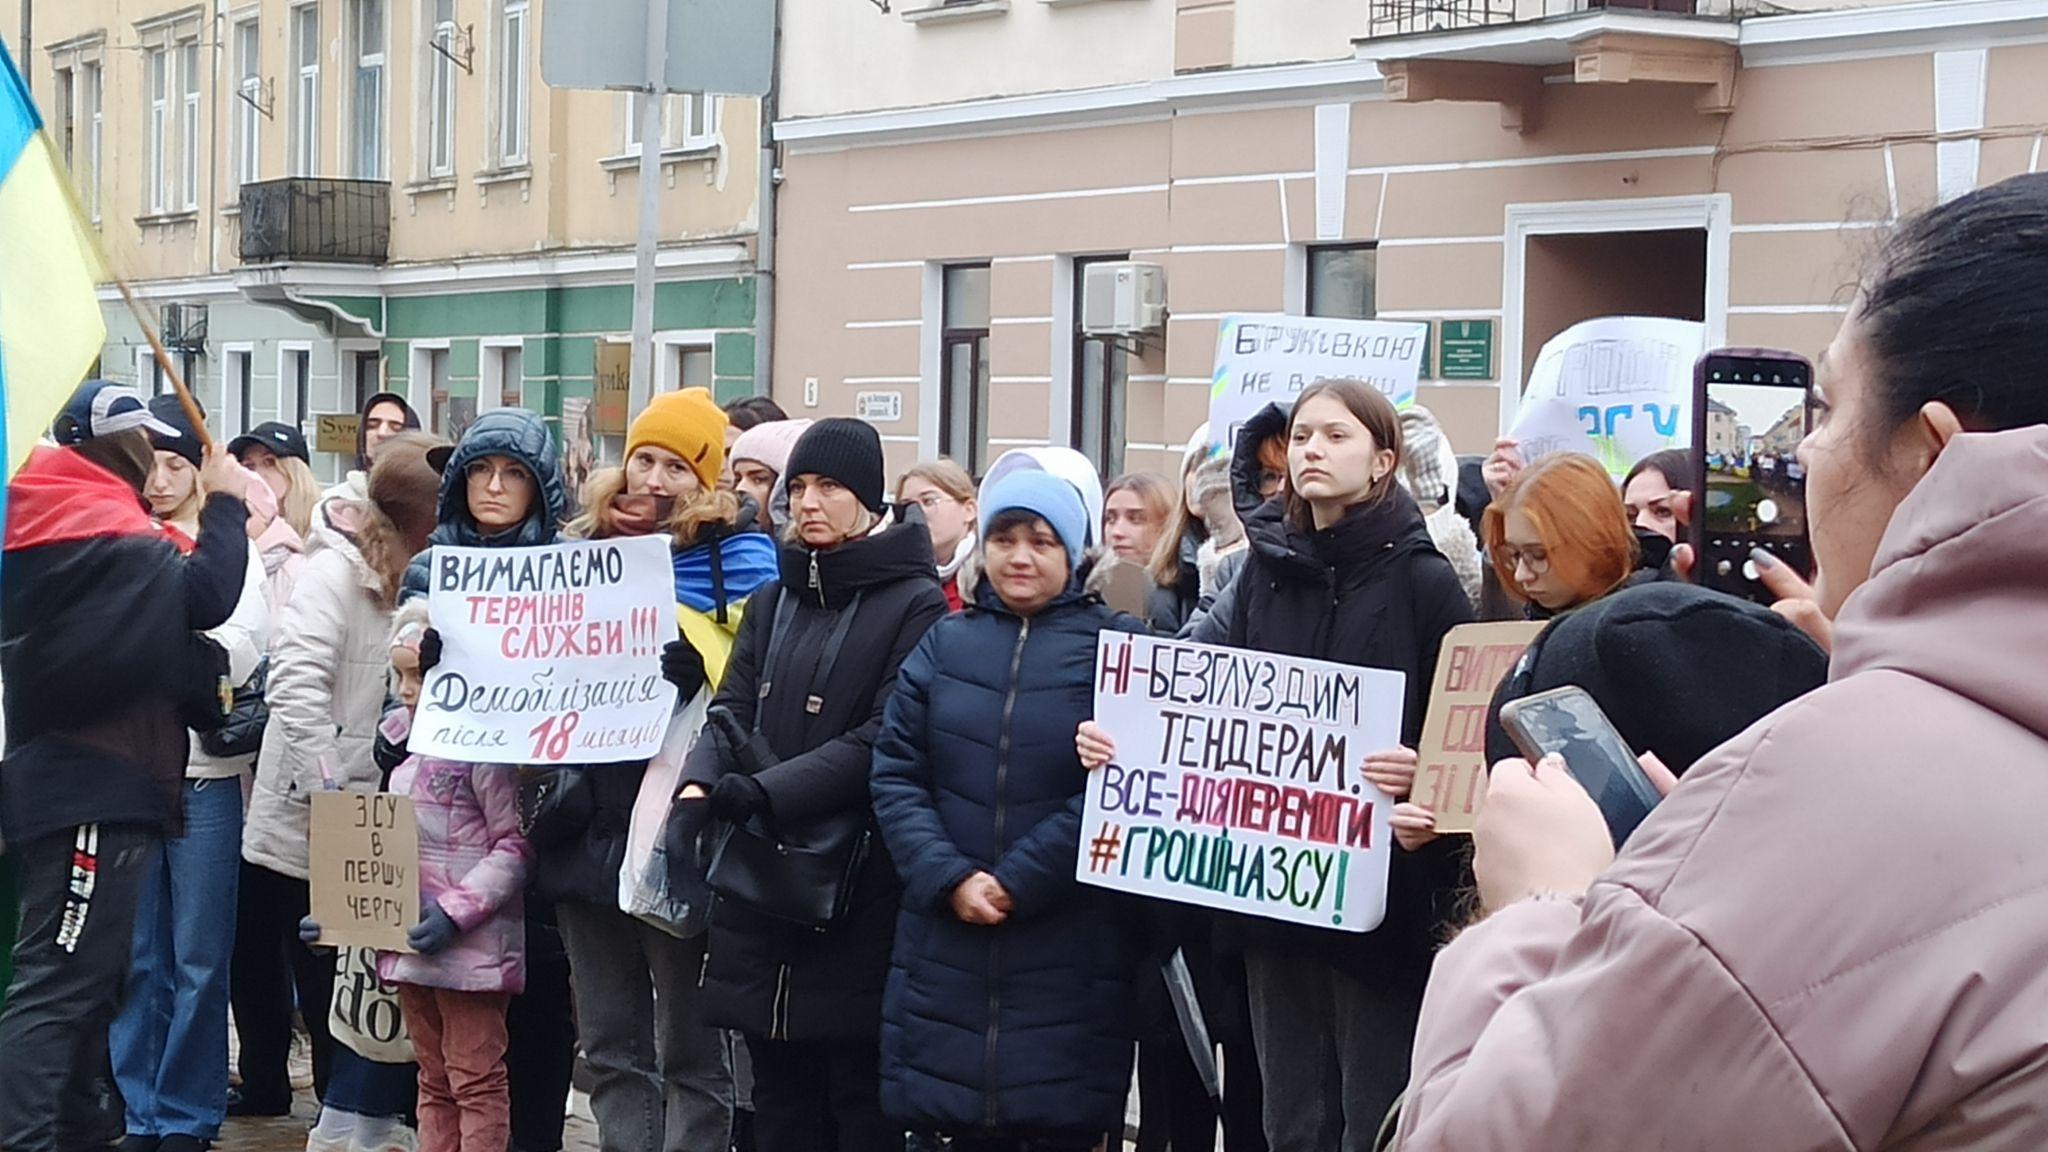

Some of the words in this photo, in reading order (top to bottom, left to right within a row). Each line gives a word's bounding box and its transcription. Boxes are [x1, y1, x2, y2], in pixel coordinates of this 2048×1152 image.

[1241, 372, 1272, 396] НЕ
[439, 547, 623, 592] ВИМАГАЄМО
[466, 588, 585, 624] ТЕРМІНІВ
[425, 667, 660, 713] Демобілізація
[431, 727, 509, 746] після
[528, 711, 579, 760] 18
[1159, 710, 1360, 795] ТЕНДЕРАМ.
[355, 795, 397, 829] ЗСУ
[371, 832, 383, 857] В
[345, 860, 405, 888] ПЕРШУ
[347, 894, 403, 927] ЧЕРГУ
